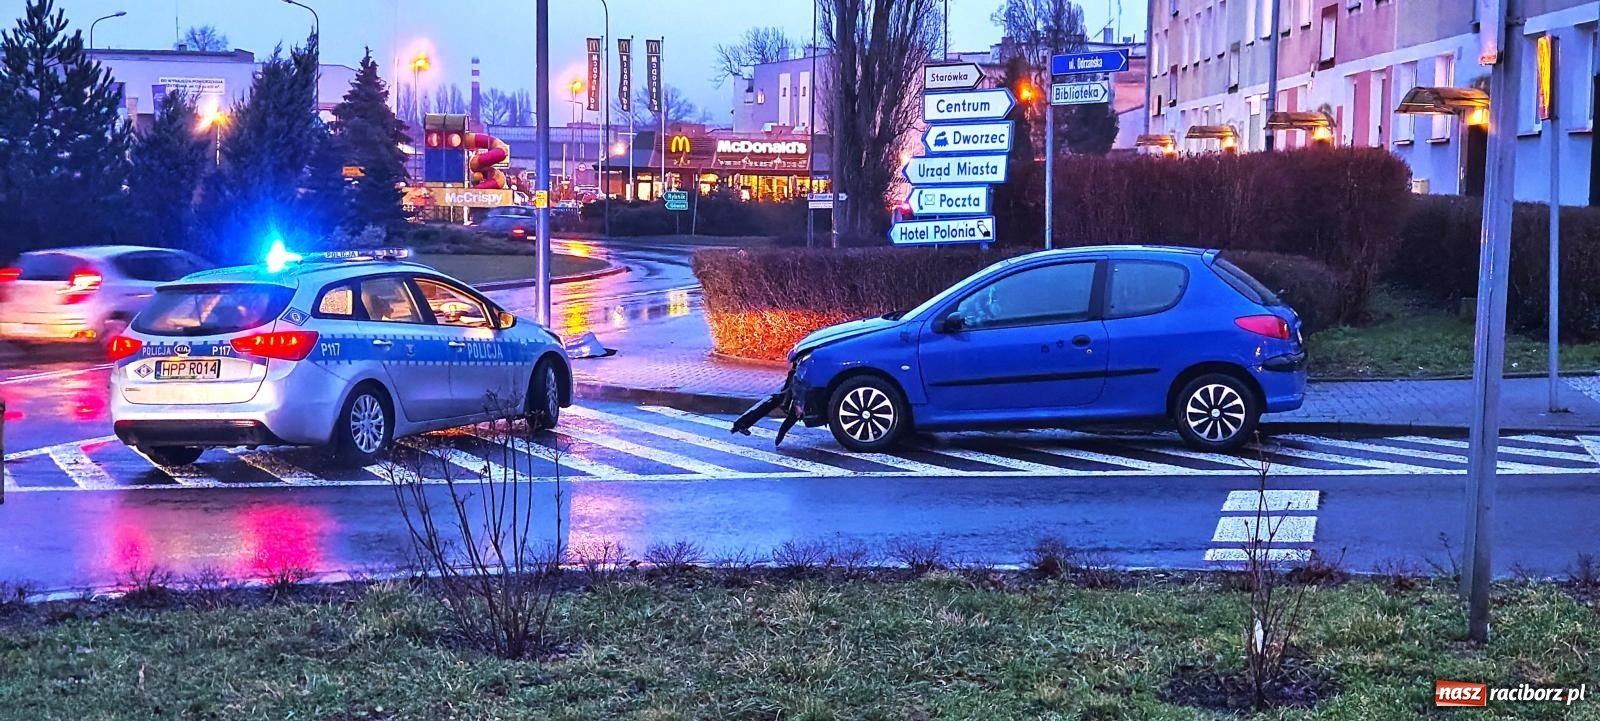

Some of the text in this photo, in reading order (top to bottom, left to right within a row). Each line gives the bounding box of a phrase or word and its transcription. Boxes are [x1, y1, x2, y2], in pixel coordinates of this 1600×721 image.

[1077, 58, 1102, 69] Odrzańska
[930, 72, 968, 83] Starówka
[1055, 84, 1099, 100] Biblioteka
[936, 99, 990, 113] Centrum
[953, 131, 1005, 145] Dworzec
[717, 140, 807, 154] McDonald's
[918, 161, 998, 180] Urząd Miasta
[445, 192, 502, 205] McCrispy
[939, 194, 981, 208] Poczta
[900, 223, 976, 241] Hotel Polonia
[142, 346, 171, 355] POLICJA
[212, 345, 231, 356] P117
[321, 342, 341, 357] P117
[467, 343, 503, 359] POLICJA
[162, 362, 217, 376] HPP R014
